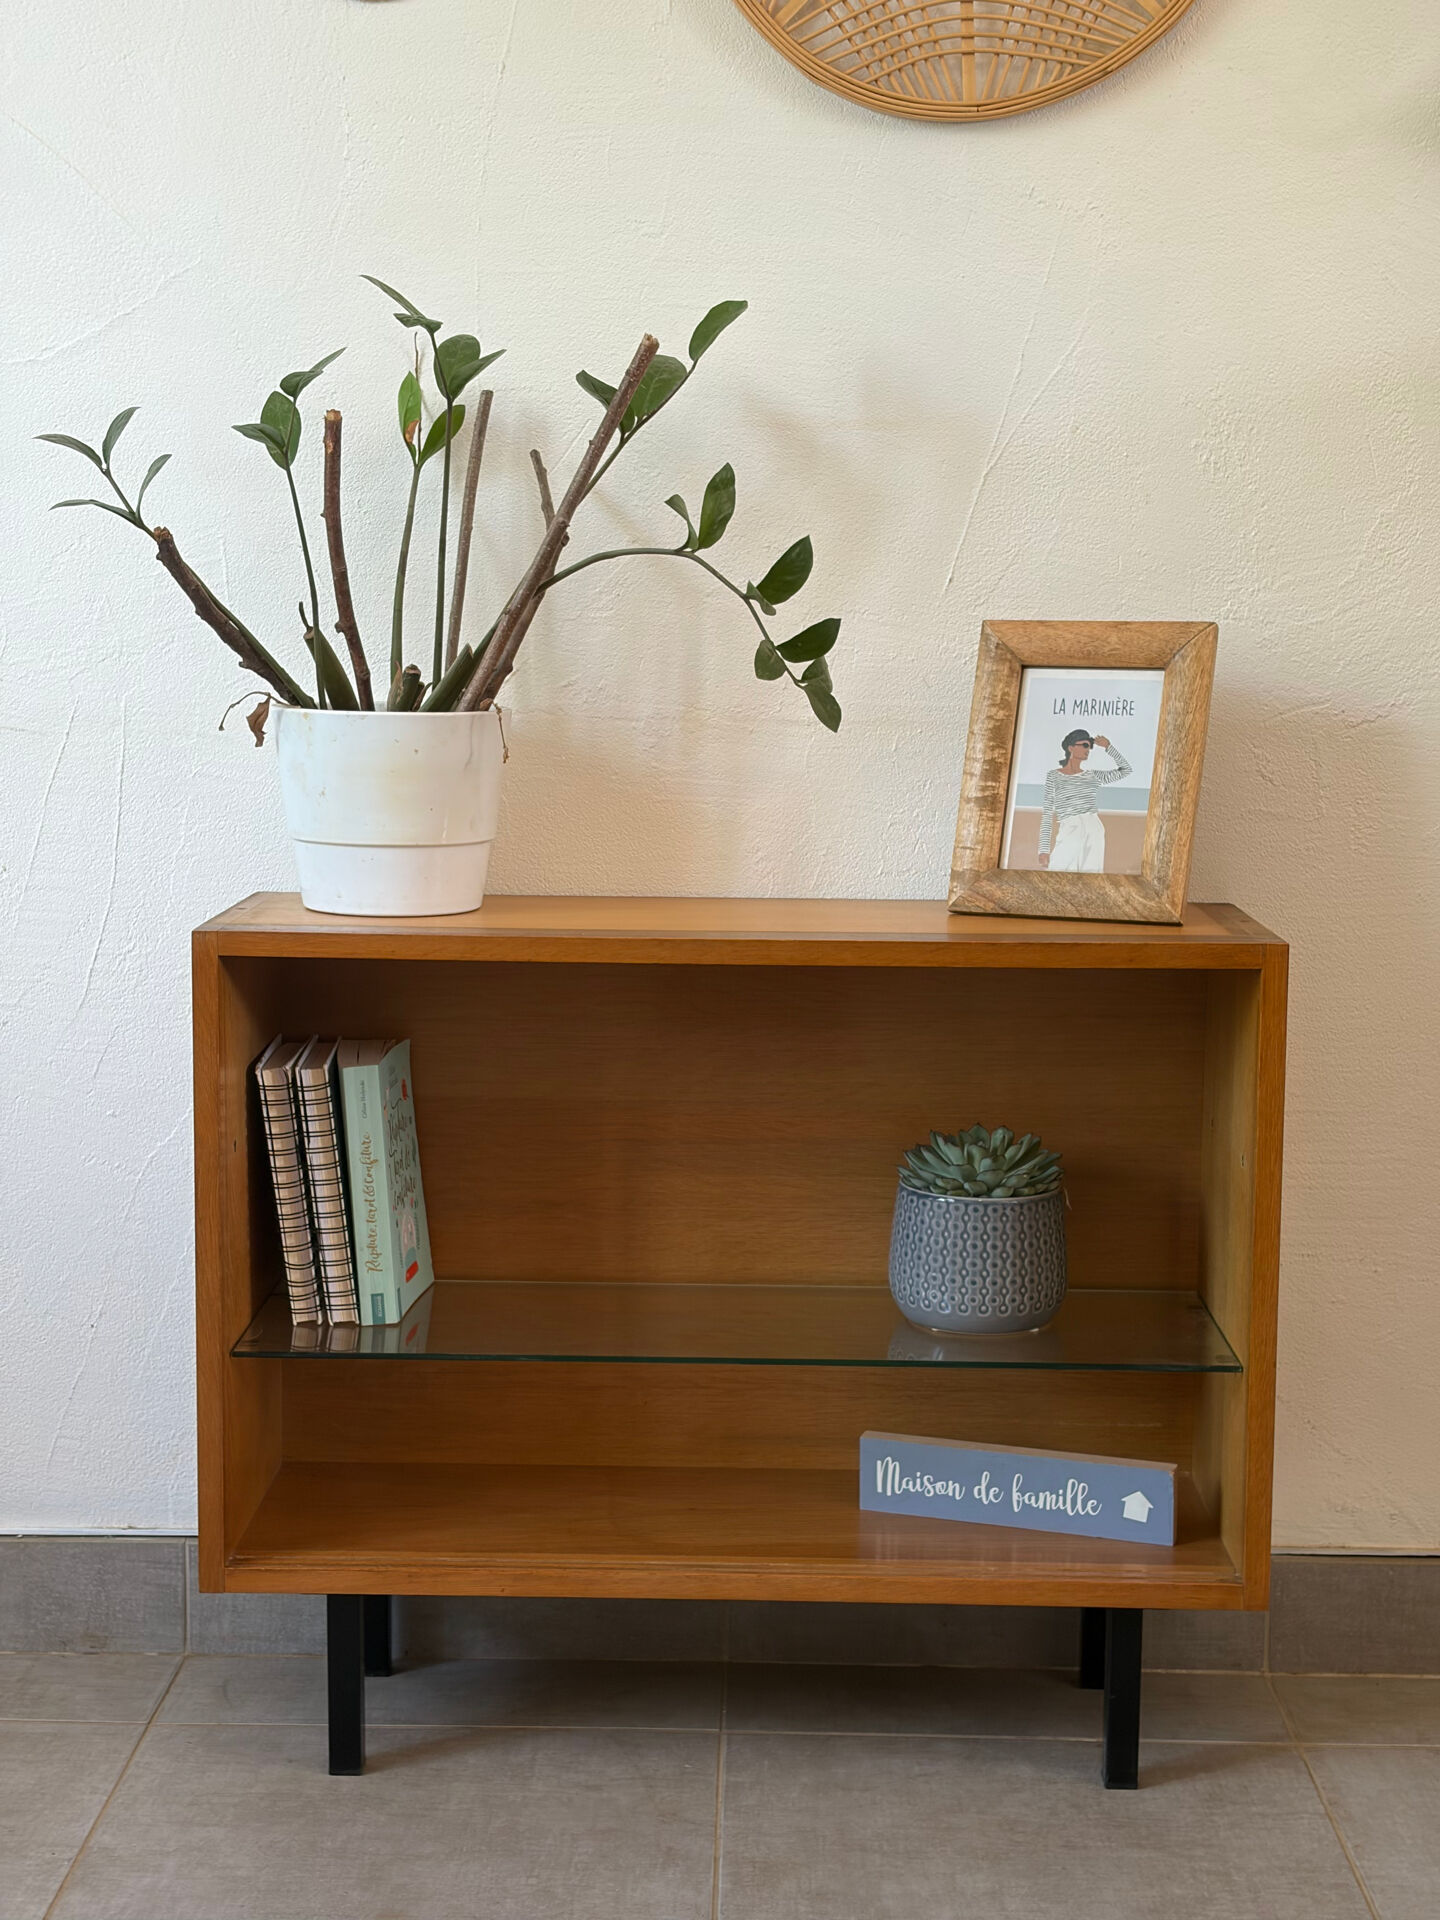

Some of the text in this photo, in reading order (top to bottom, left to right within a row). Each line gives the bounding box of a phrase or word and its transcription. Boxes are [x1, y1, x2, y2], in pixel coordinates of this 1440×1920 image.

[1053, 696, 1135, 717] LA MARINIÈRE
[362, 1184, 375, 1197] &
[363, 1199, 378, 1224] tarot
[876, 1456, 1102, 1516] Maison de famille
